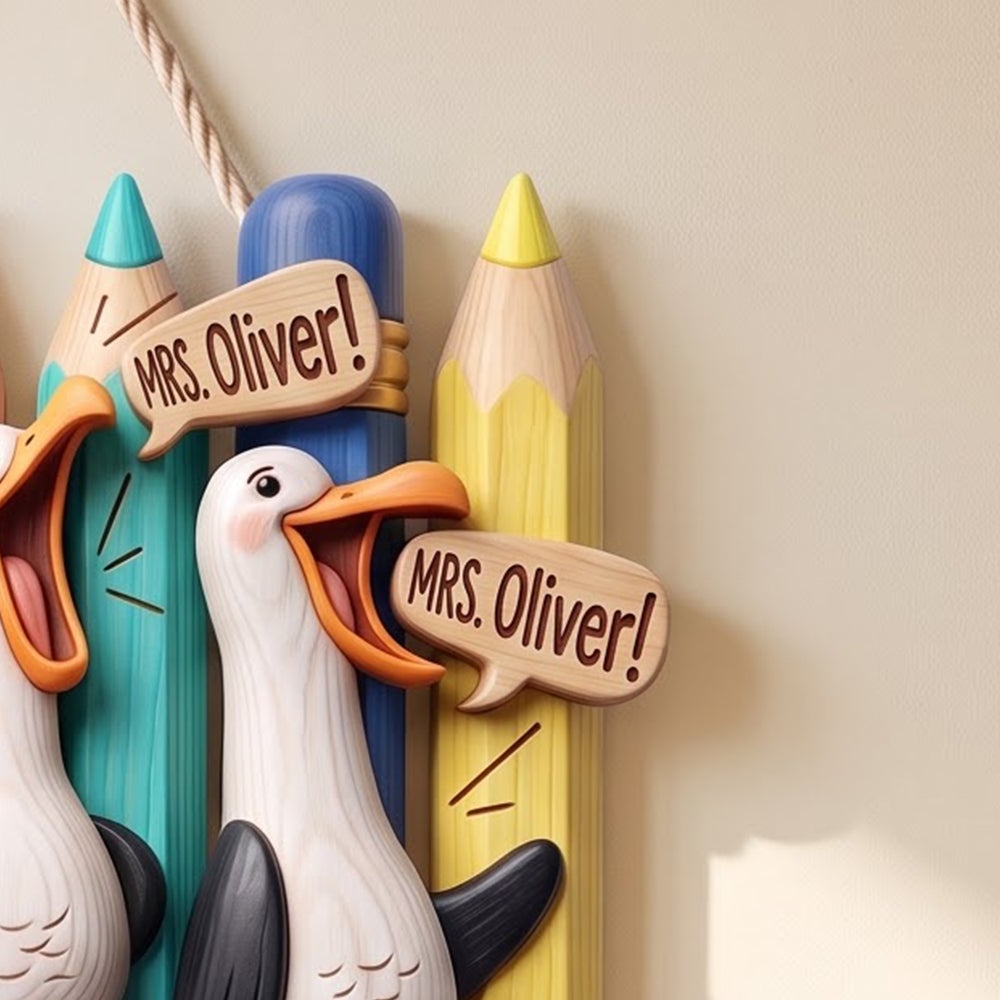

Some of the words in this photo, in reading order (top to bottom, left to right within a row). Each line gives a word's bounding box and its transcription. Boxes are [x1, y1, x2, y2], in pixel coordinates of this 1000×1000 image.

[133, 337, 210, 409] MRS.
[205, 273, 366, 397] Oliver!
[407, 548, 482, 629] MRS.
[493, 563, 657, 683] Oliver!
